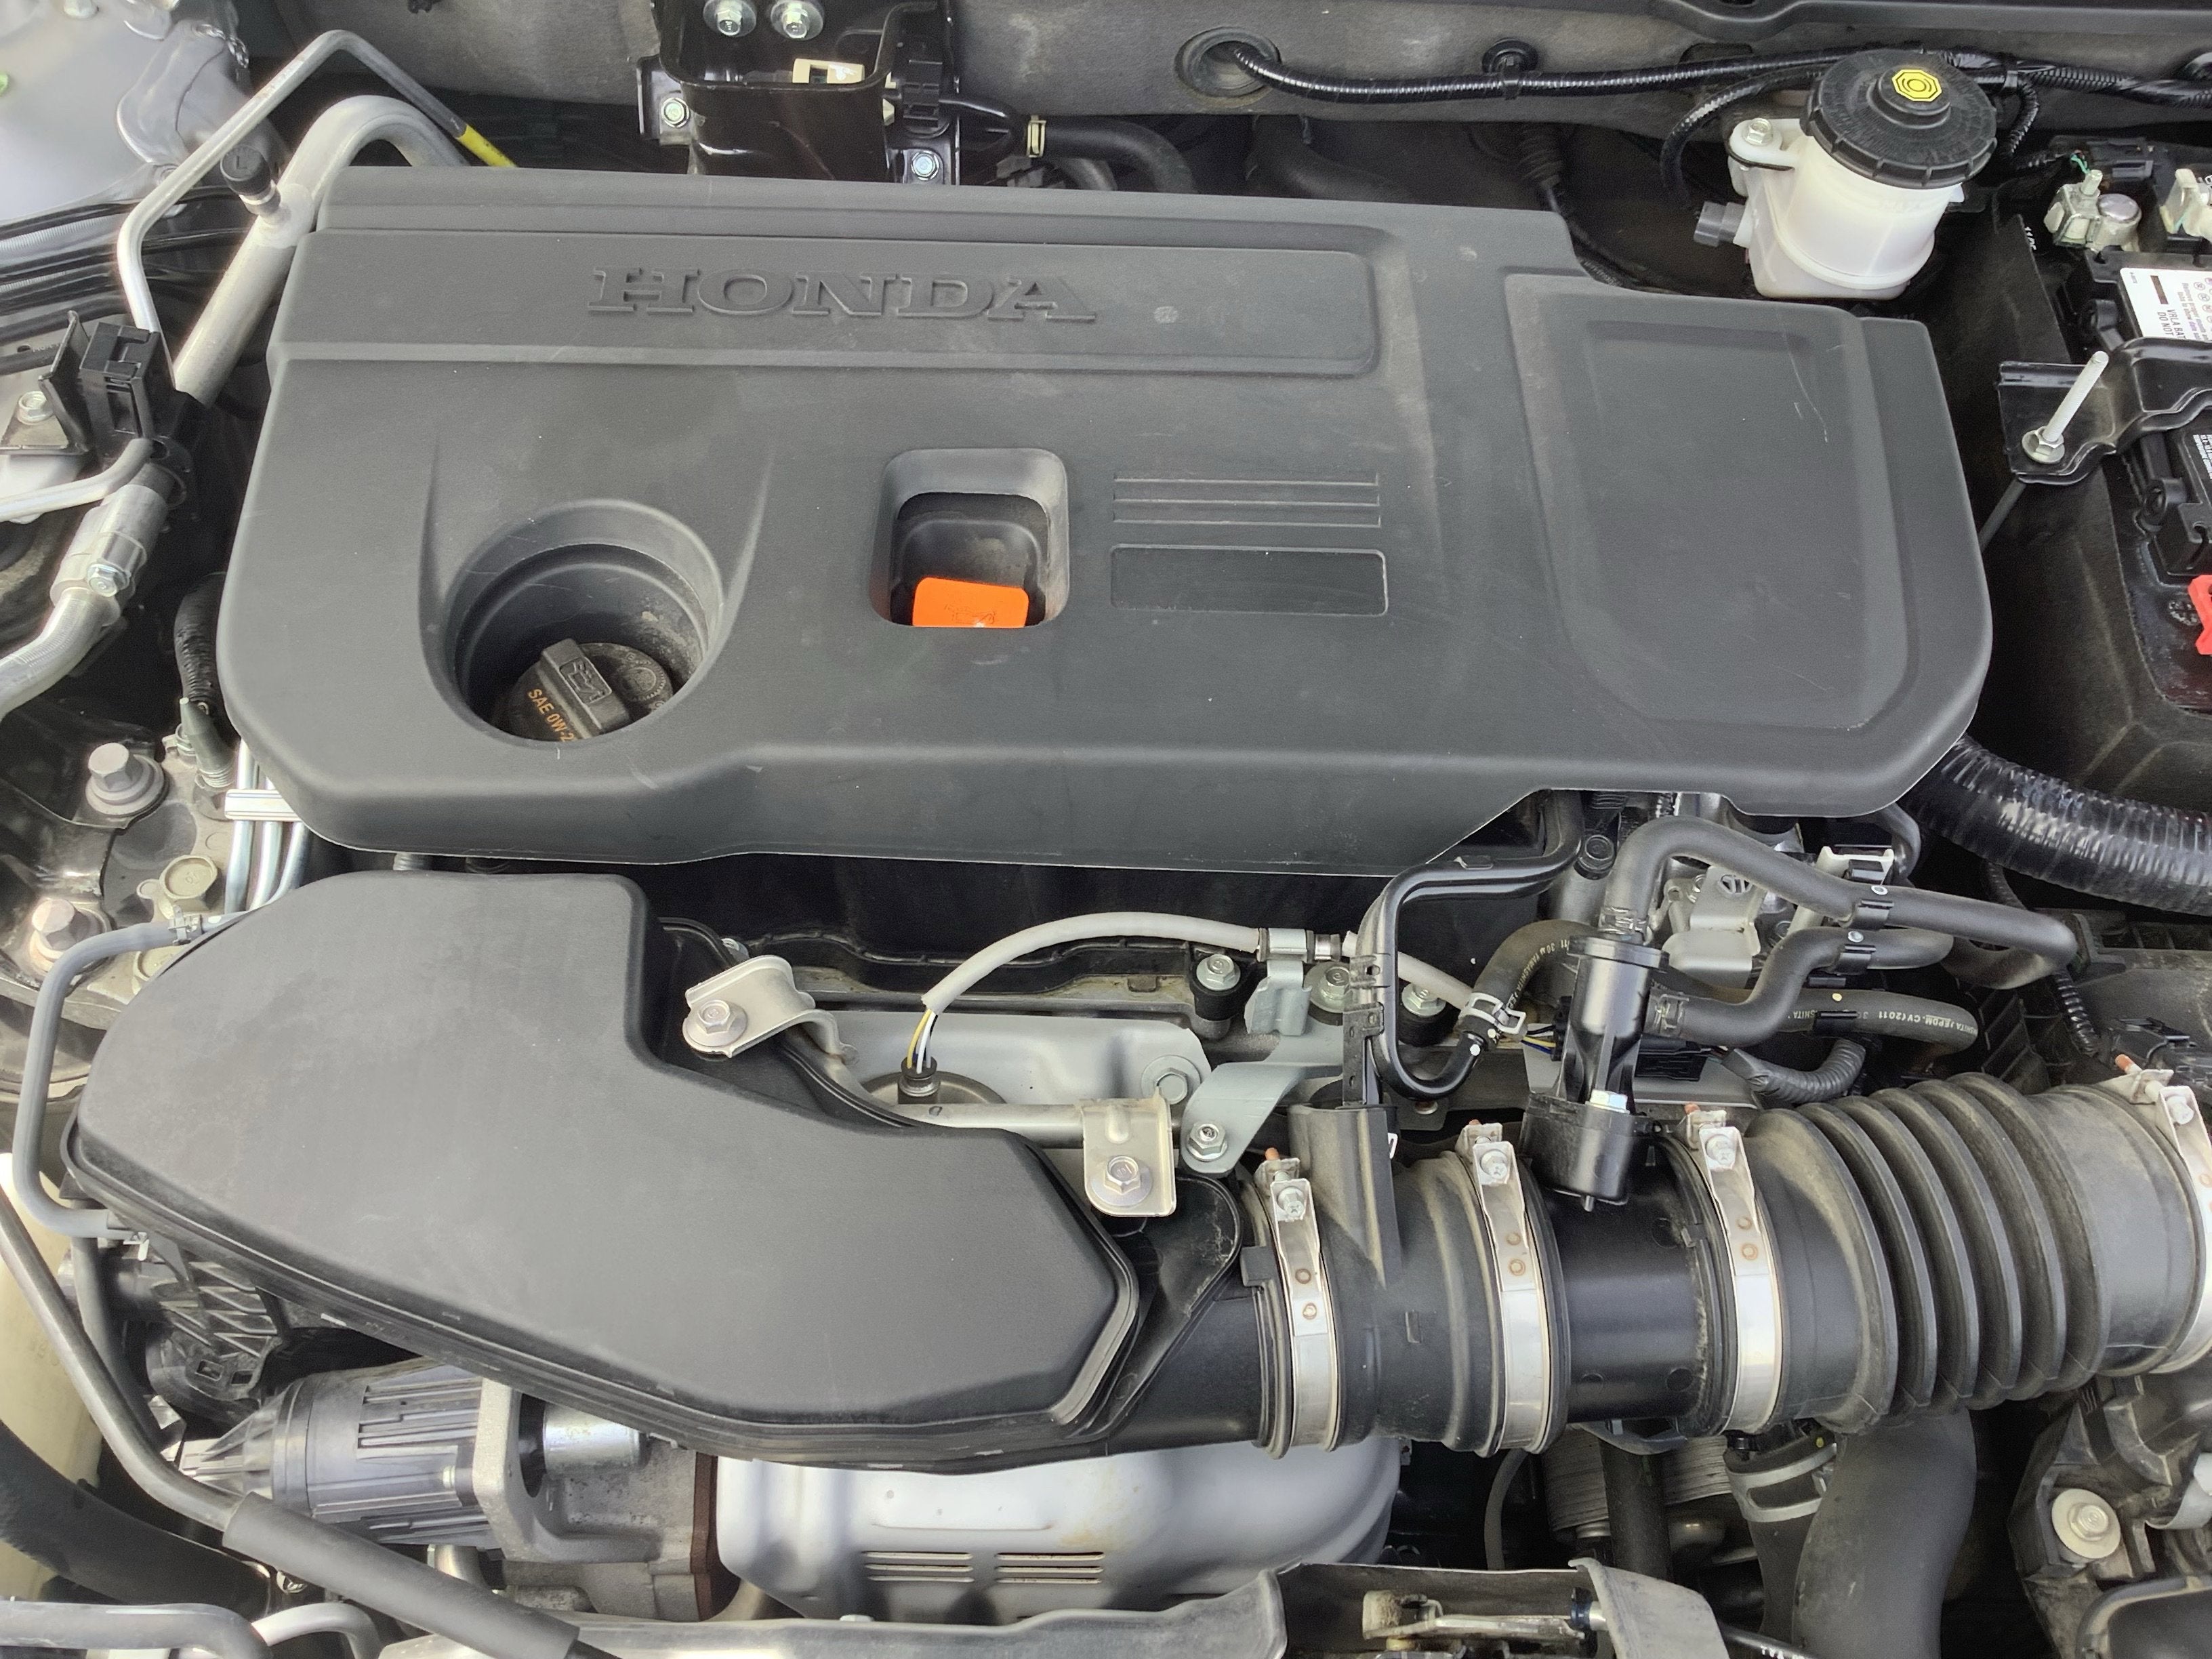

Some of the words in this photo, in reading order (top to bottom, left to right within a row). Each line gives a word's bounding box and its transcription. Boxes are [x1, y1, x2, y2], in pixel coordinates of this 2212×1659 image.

[588, 268, 1097, 321] HONDA
[2157, 312, 2168, 321] DO
[2167, 309, 2180, 326] VRLA
[2161, 323, 2174, 335] NOT
[528, 689, 554, 714] SAE
[546, 713, 576, 743] 0W-2
[1793, 1009, 1818, 1019] SHITA
